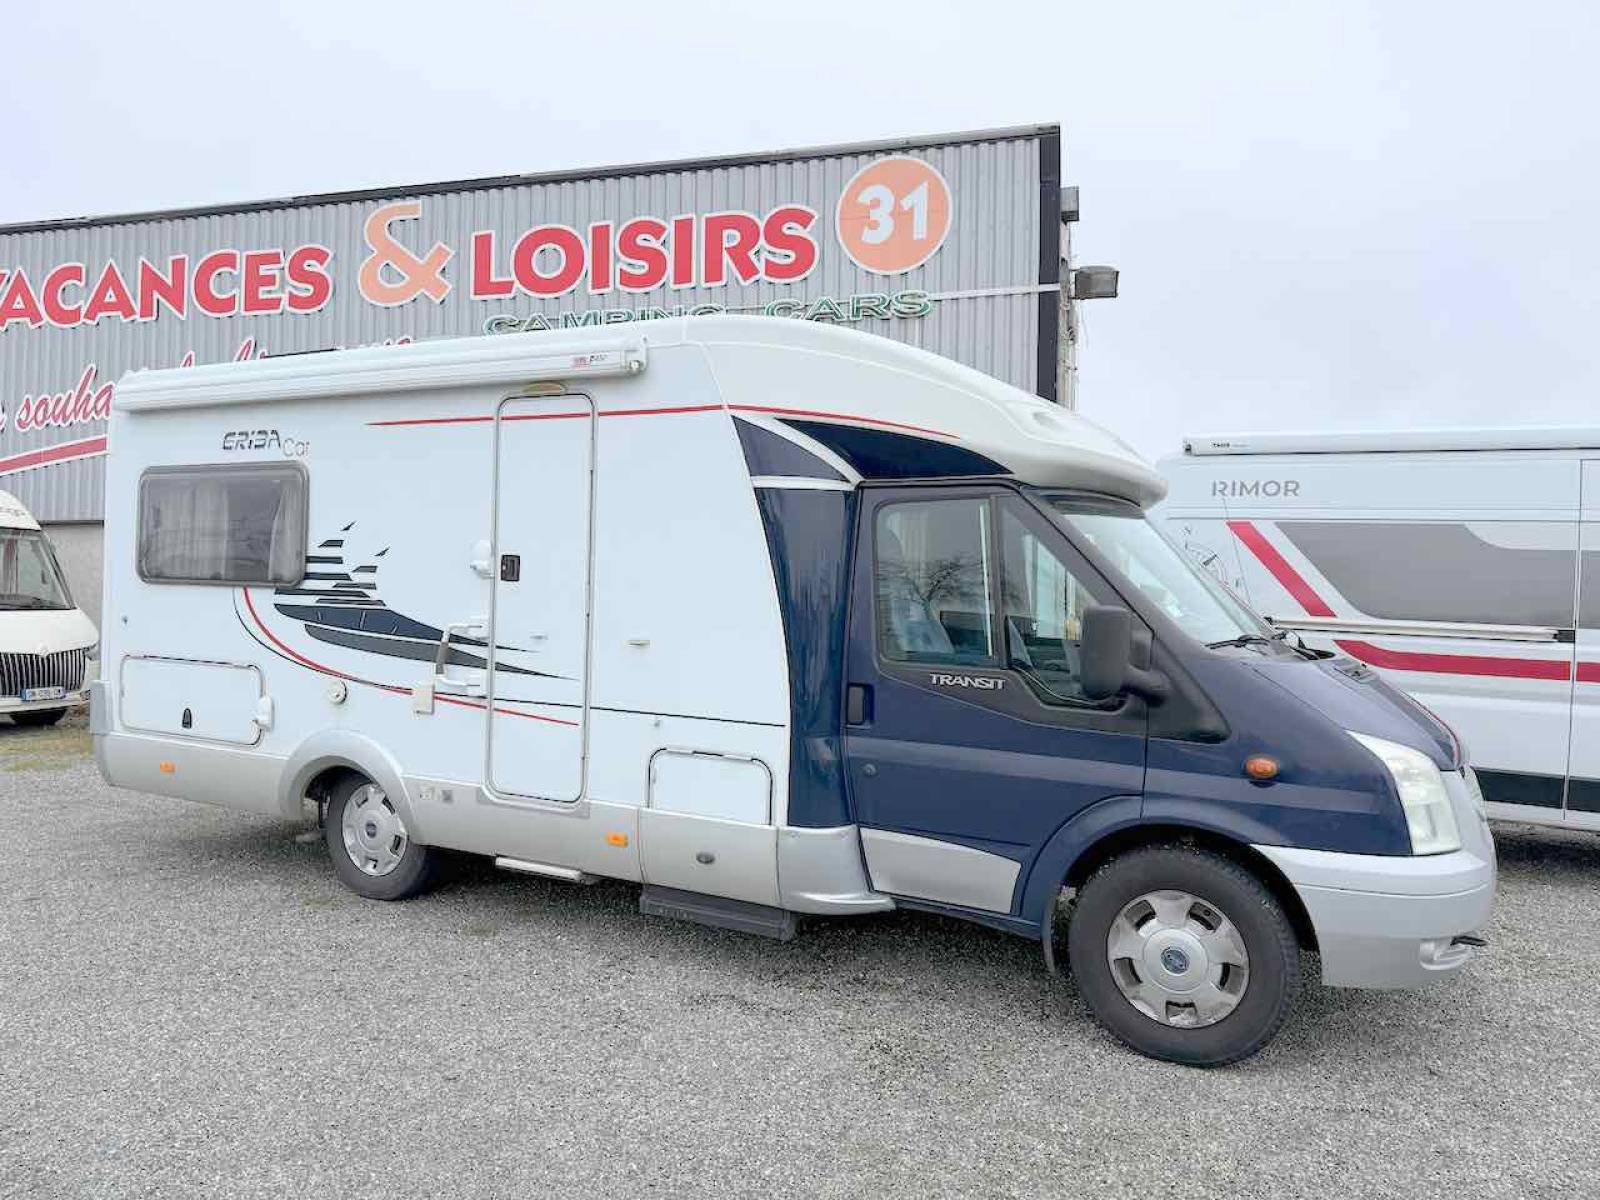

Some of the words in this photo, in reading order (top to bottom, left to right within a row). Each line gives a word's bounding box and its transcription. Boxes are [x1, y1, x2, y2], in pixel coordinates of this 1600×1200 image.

[0, 245, 333, 331] ACANCES
[359, 200, 455, 307] &
[470, 203, 819, 300] LOISIRS
[857, 180, 930, 246] 31
[764, 289, 932, 322] CARS
[15, 363, 115, 431] souha
[1211, 479, 1301, 497] RIMOR
[929, 672, 1006, 690] TRANSIT
